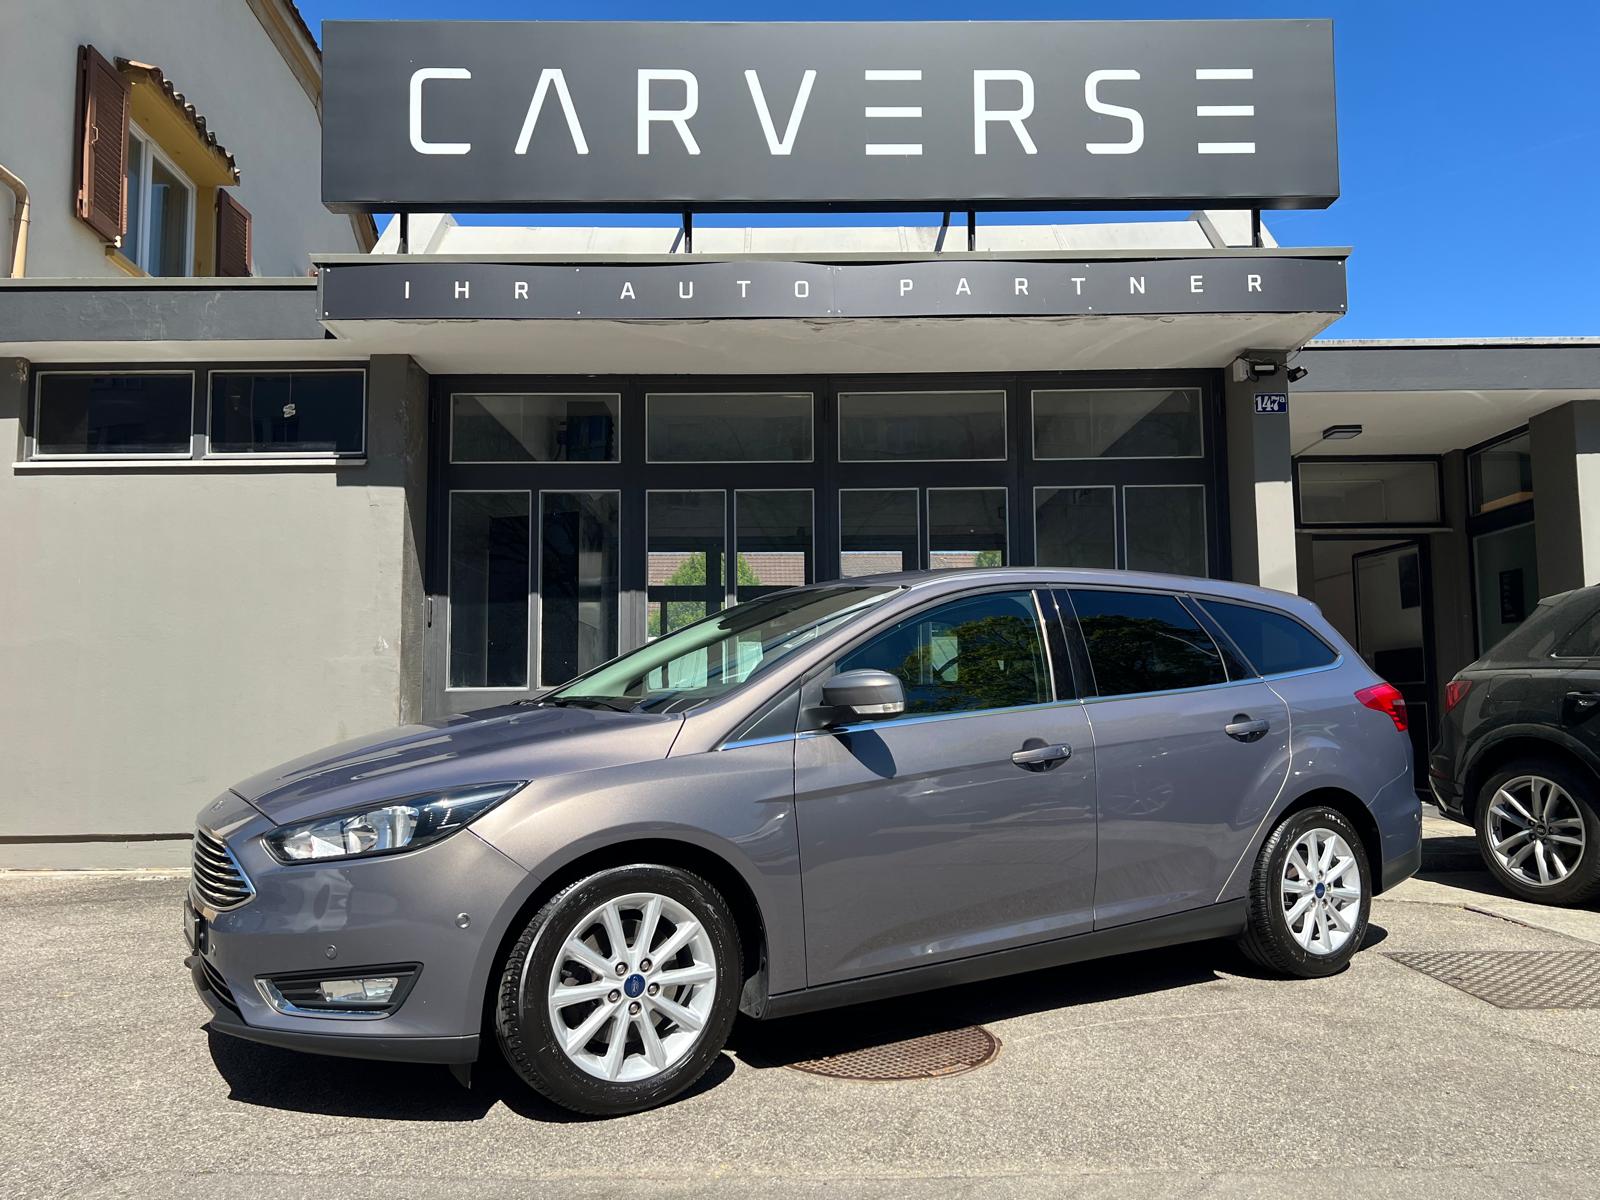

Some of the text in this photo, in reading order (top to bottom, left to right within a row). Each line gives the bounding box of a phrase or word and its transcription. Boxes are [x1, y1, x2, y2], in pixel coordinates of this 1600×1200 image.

[409, 67, 1256, 156] CARVERSE
[404, 274, 1263, 300] IHR AUTO PARTNER
